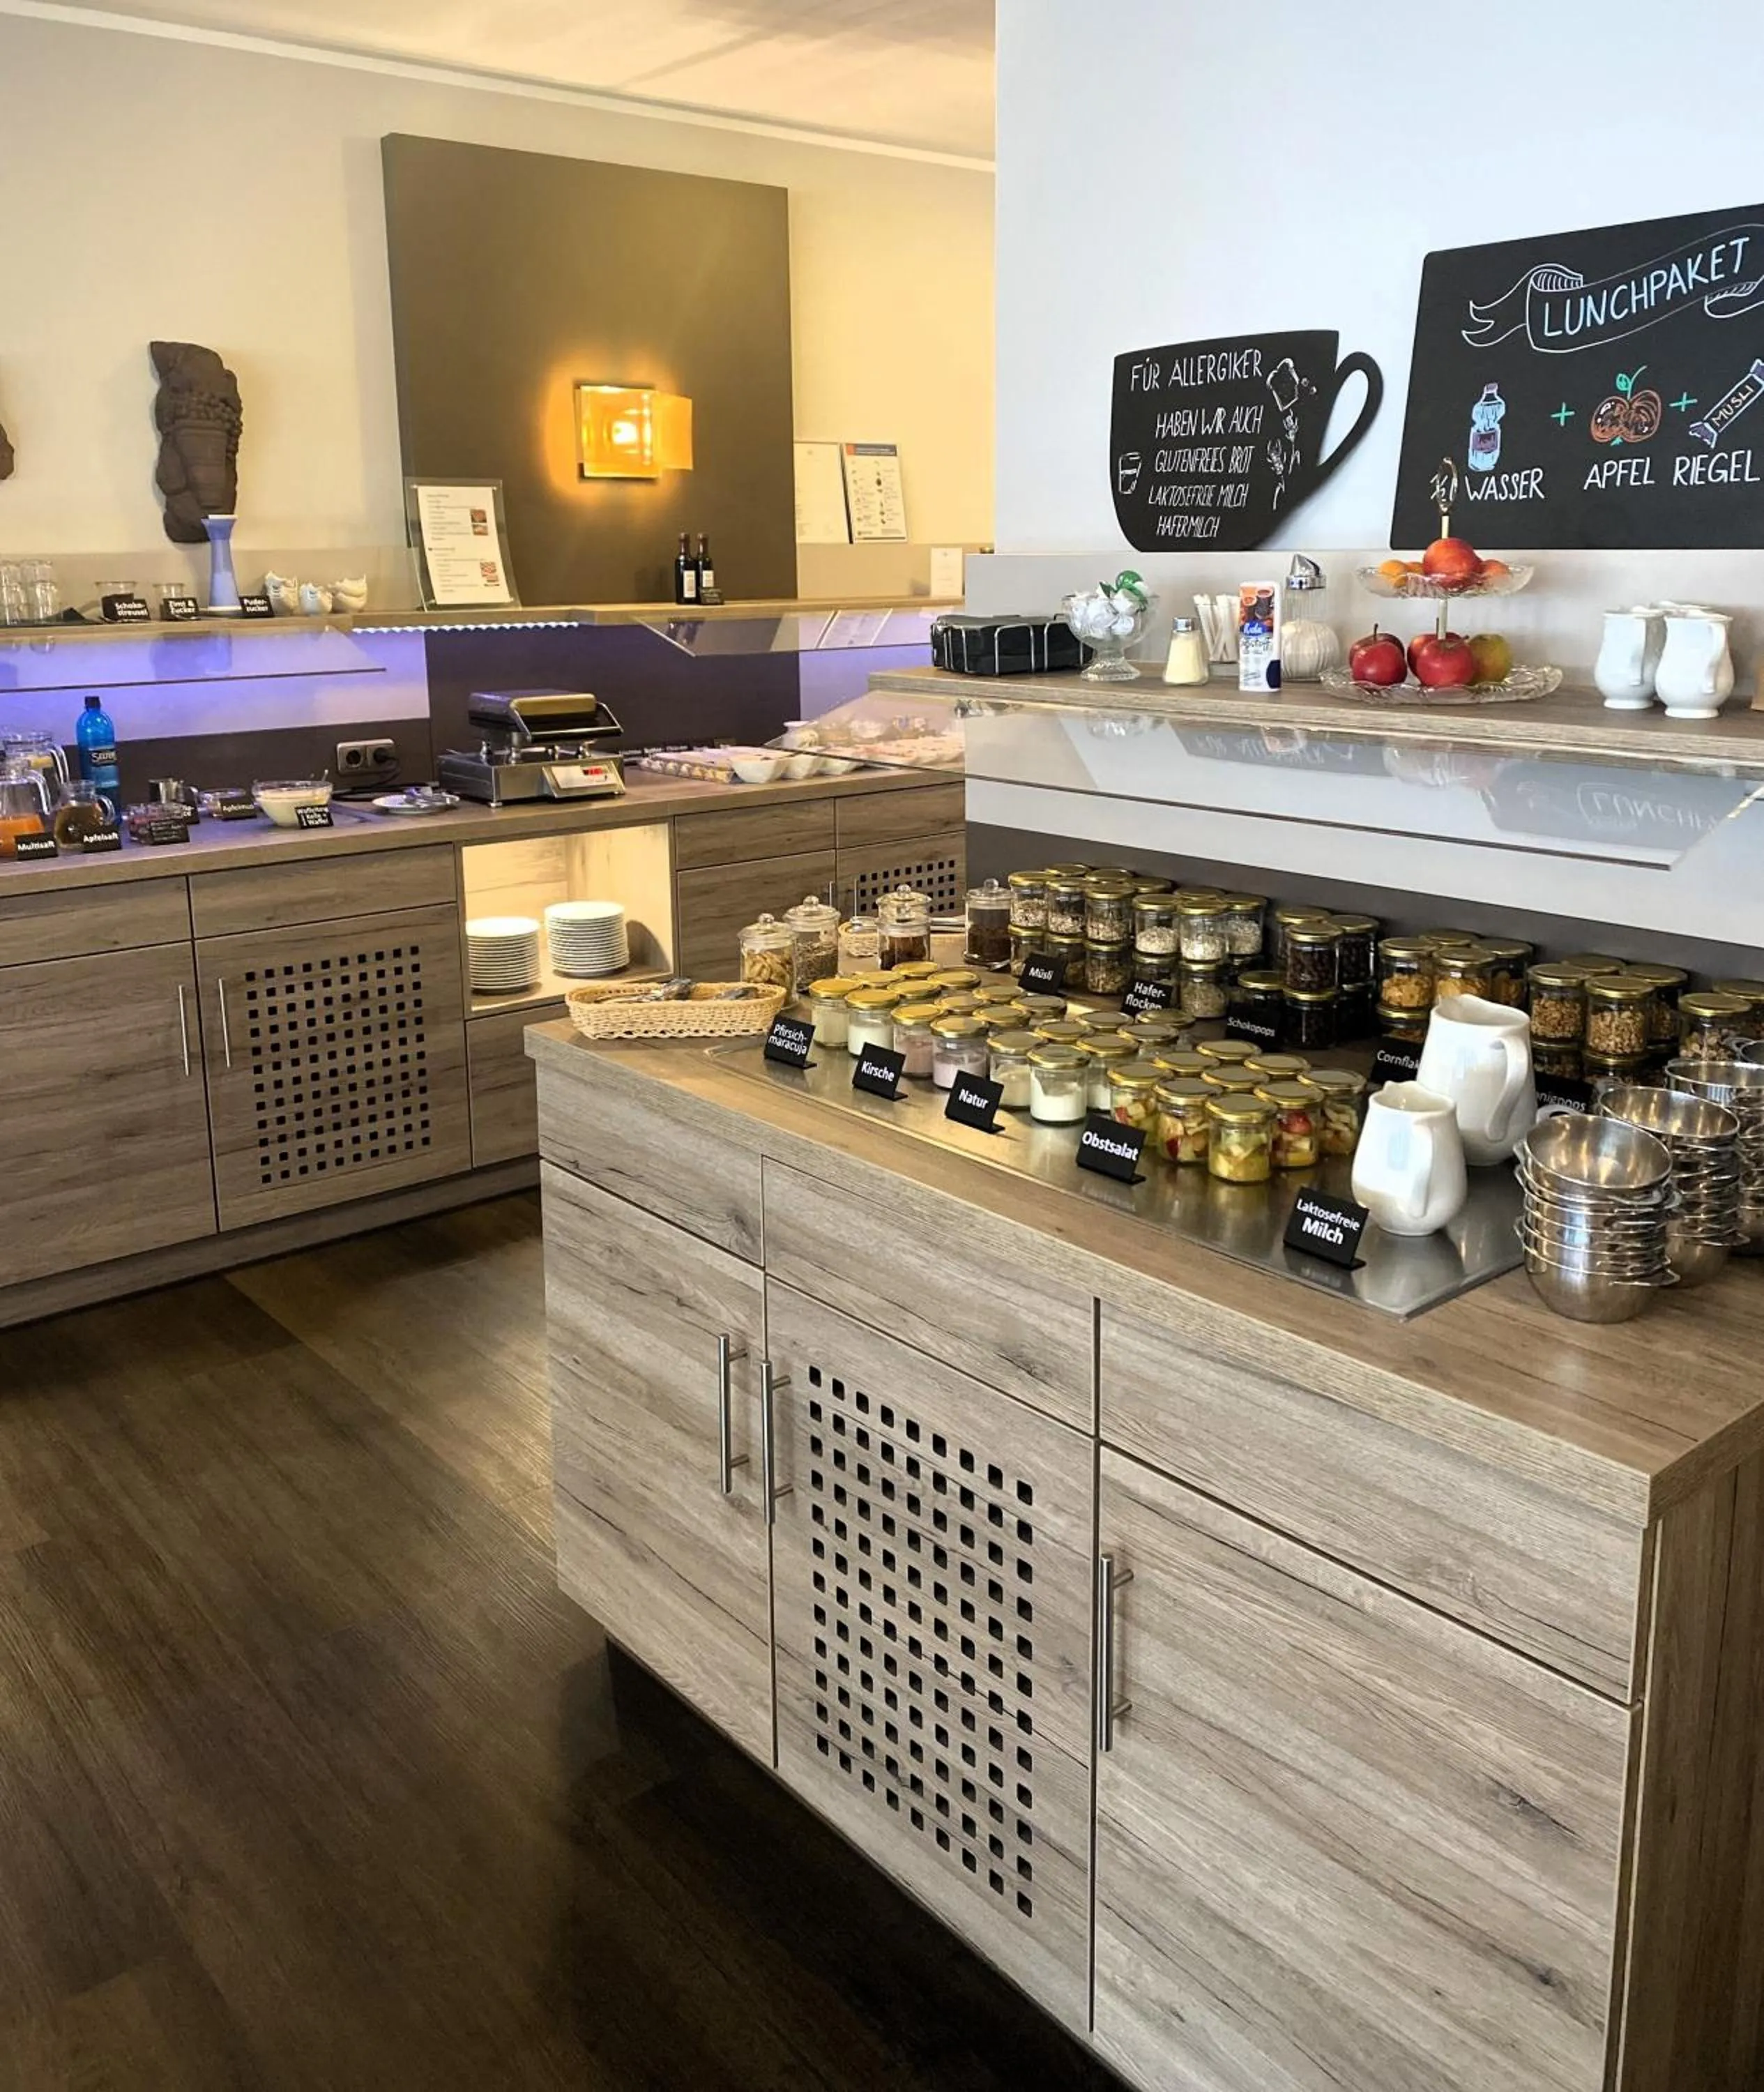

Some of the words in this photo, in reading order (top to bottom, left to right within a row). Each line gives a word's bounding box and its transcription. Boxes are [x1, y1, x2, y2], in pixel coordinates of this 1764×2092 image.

[1543, 236, 1750, 337] LUNCHPAKET
[1130, 356, 1161, 391] FÜR
[1168, 349, 1263, 388] ALLERGIKER
[1155, 408, 1199, 439] HABEN
[1228, 404, 1265, 434] AUCH
[1228, 446, 1255, 473] BROT
[1465, 468, 1546, 501] WASSER
[1584, 457, 1655, 490] APFEL
[1673, 450, 1761, 487] RIEGEL
[1217, 483, 1250, 508] MILCH
[1155, 515, 1221, 538] HAFERMILCH
[17, 840, 55, 851] Multisaft
[83, 832, 119, 843] Apfelsaft
[1134, 981, 1166, 999] Hafer-
[773, 1023, 808, 1043] Pfirsich-
[1227, 1016, 1276, 1038] Schokopops
[768, 1036, 808, 1056] maracuja
[861, 1061, 895, 1082] Kirsche
[958, 1089, 989, 1109] Natur
[1081, 1130, 1139, 1161] Obstsalat
[1297, 1198, 1360, 1231] Laktosefreie
[1302, 1217, 1344, 1245] Milch
